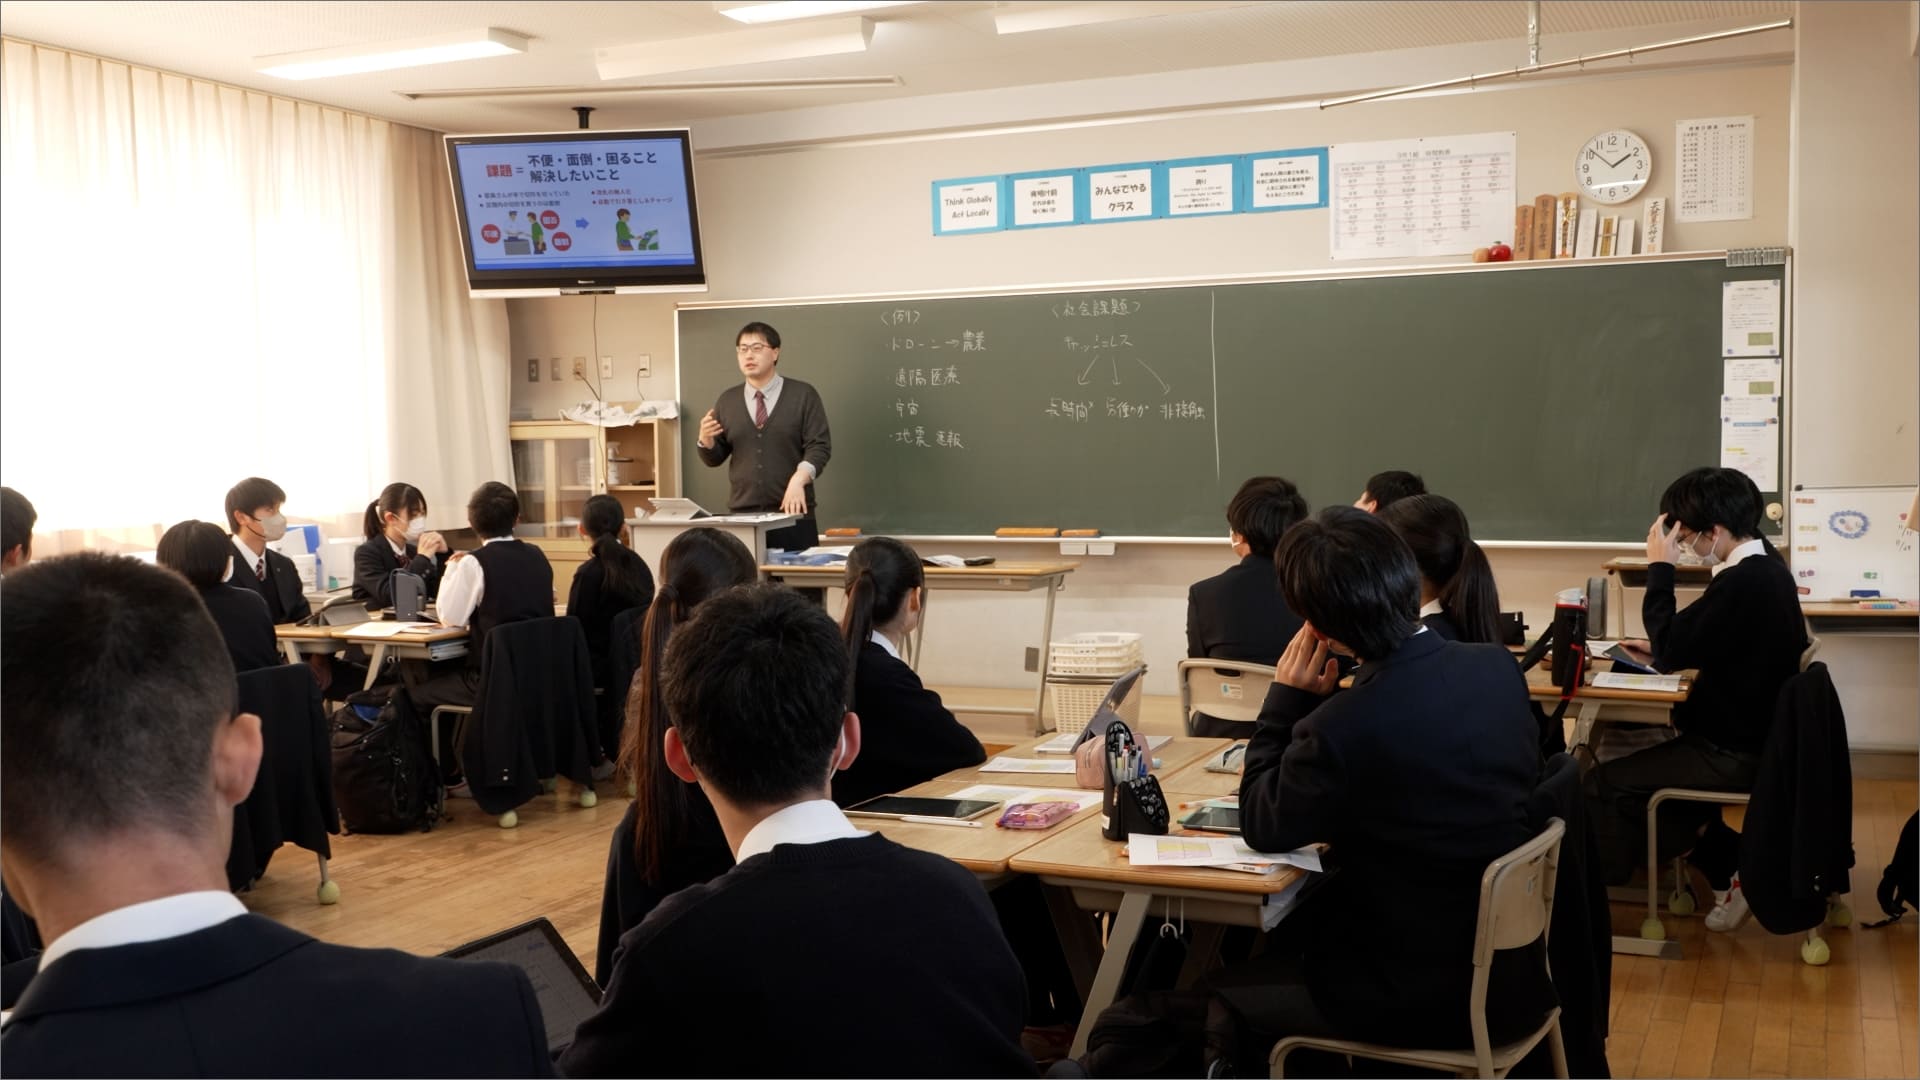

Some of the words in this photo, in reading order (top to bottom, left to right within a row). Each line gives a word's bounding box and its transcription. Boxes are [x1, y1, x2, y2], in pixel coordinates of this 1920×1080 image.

[1596, 139, 1603, 151] 11
[1607, 135, 1617, 145] 12
[1585, 150, 1595, 160] 10
[1632, 146, 1640, 157] 2
[527, 151, 657, 167] 不便・面倒・困ること
[1636, 159, 1643, 169] 3
[1582, 163, 1590, 173] 9
[530, 169, 620, 183] 解決したいこと
[1585, 176, 1593, 186] 8
[1095, 183, 1147, 196] みんなでやる
[1608, 187, 1616, 197] 6
[1622, 185, 1630, 193] 5
[944, 197, 964, 206] Think
[966, 195, 993, 204] Globally
[1108, 201, 1134, 212] クラス
[951, 210, 964, 218] Act
[966, 208, 990, 217] Locally
[895, 397, 919, 418] 宇宙
